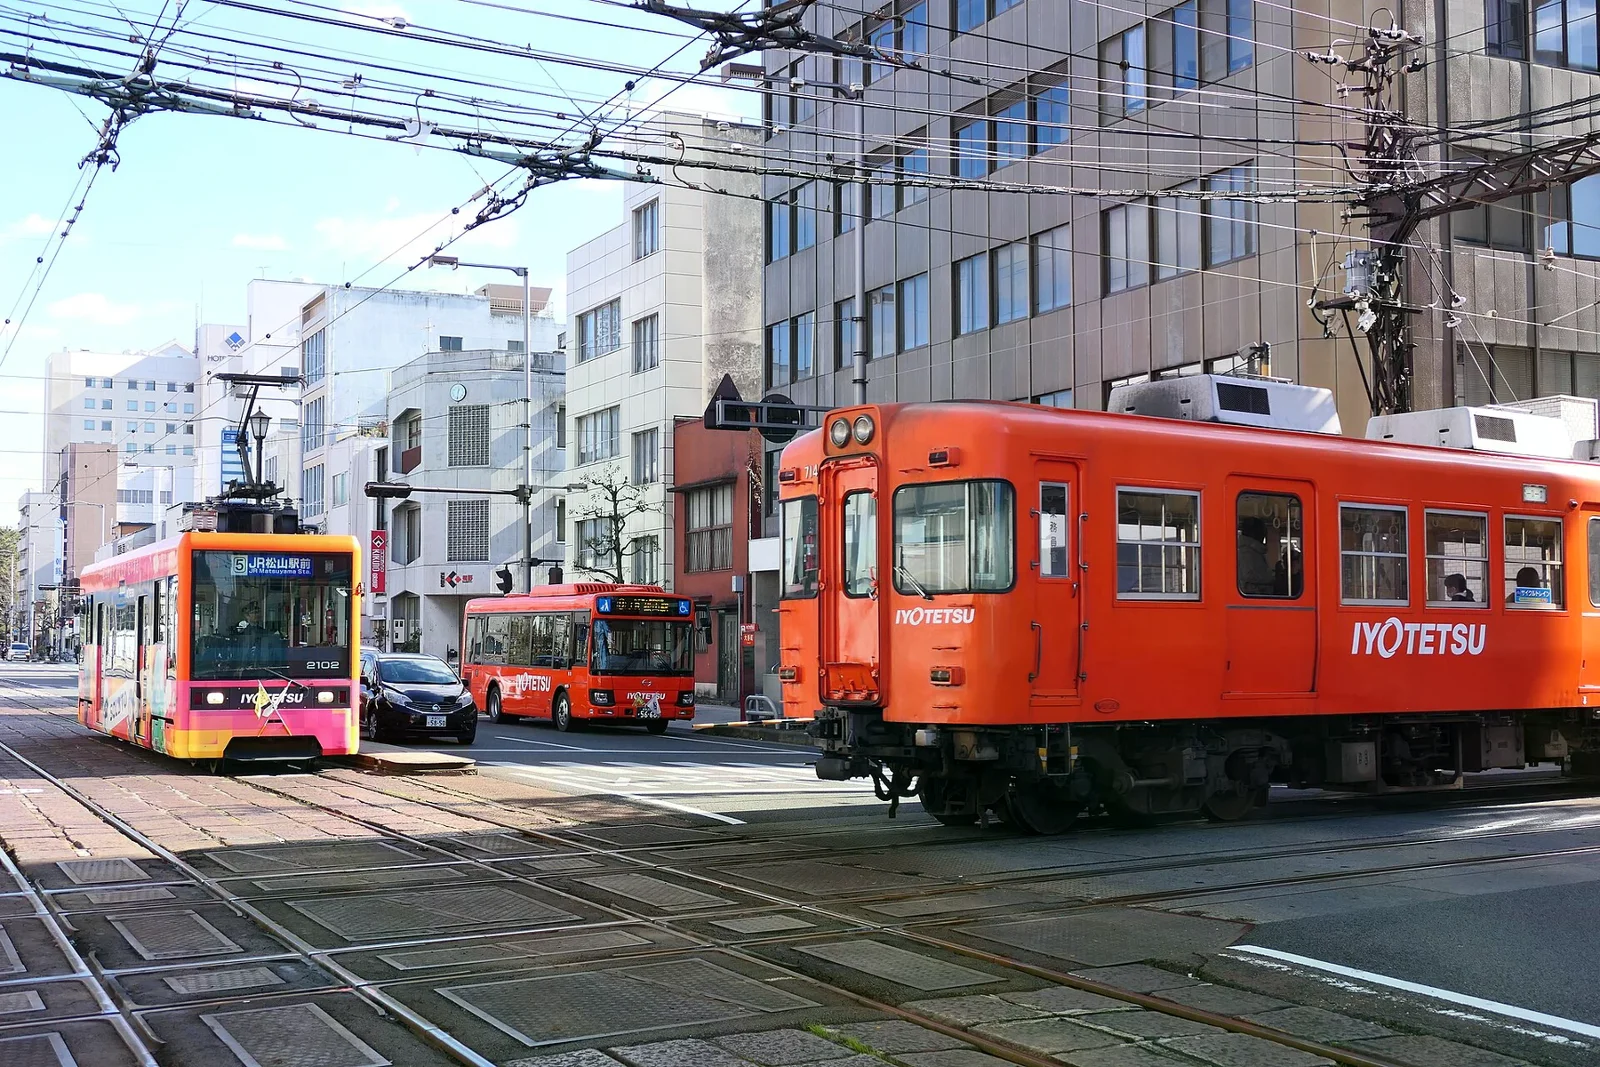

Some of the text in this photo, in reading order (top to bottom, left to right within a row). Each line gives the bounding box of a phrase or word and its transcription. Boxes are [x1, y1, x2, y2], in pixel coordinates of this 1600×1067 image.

[804, 464, 819, 479] 714
[235, 558, 243, 571] 5
[249, 557, 311, 569] JR松山駅前
[895, 607, 976, 626] IYOTETSU
[1351, 617, 1487, 659] IYOTETSU
[306, 661, 340, 670] 2102
[515, 671, 552, 692] IYOTETSU
